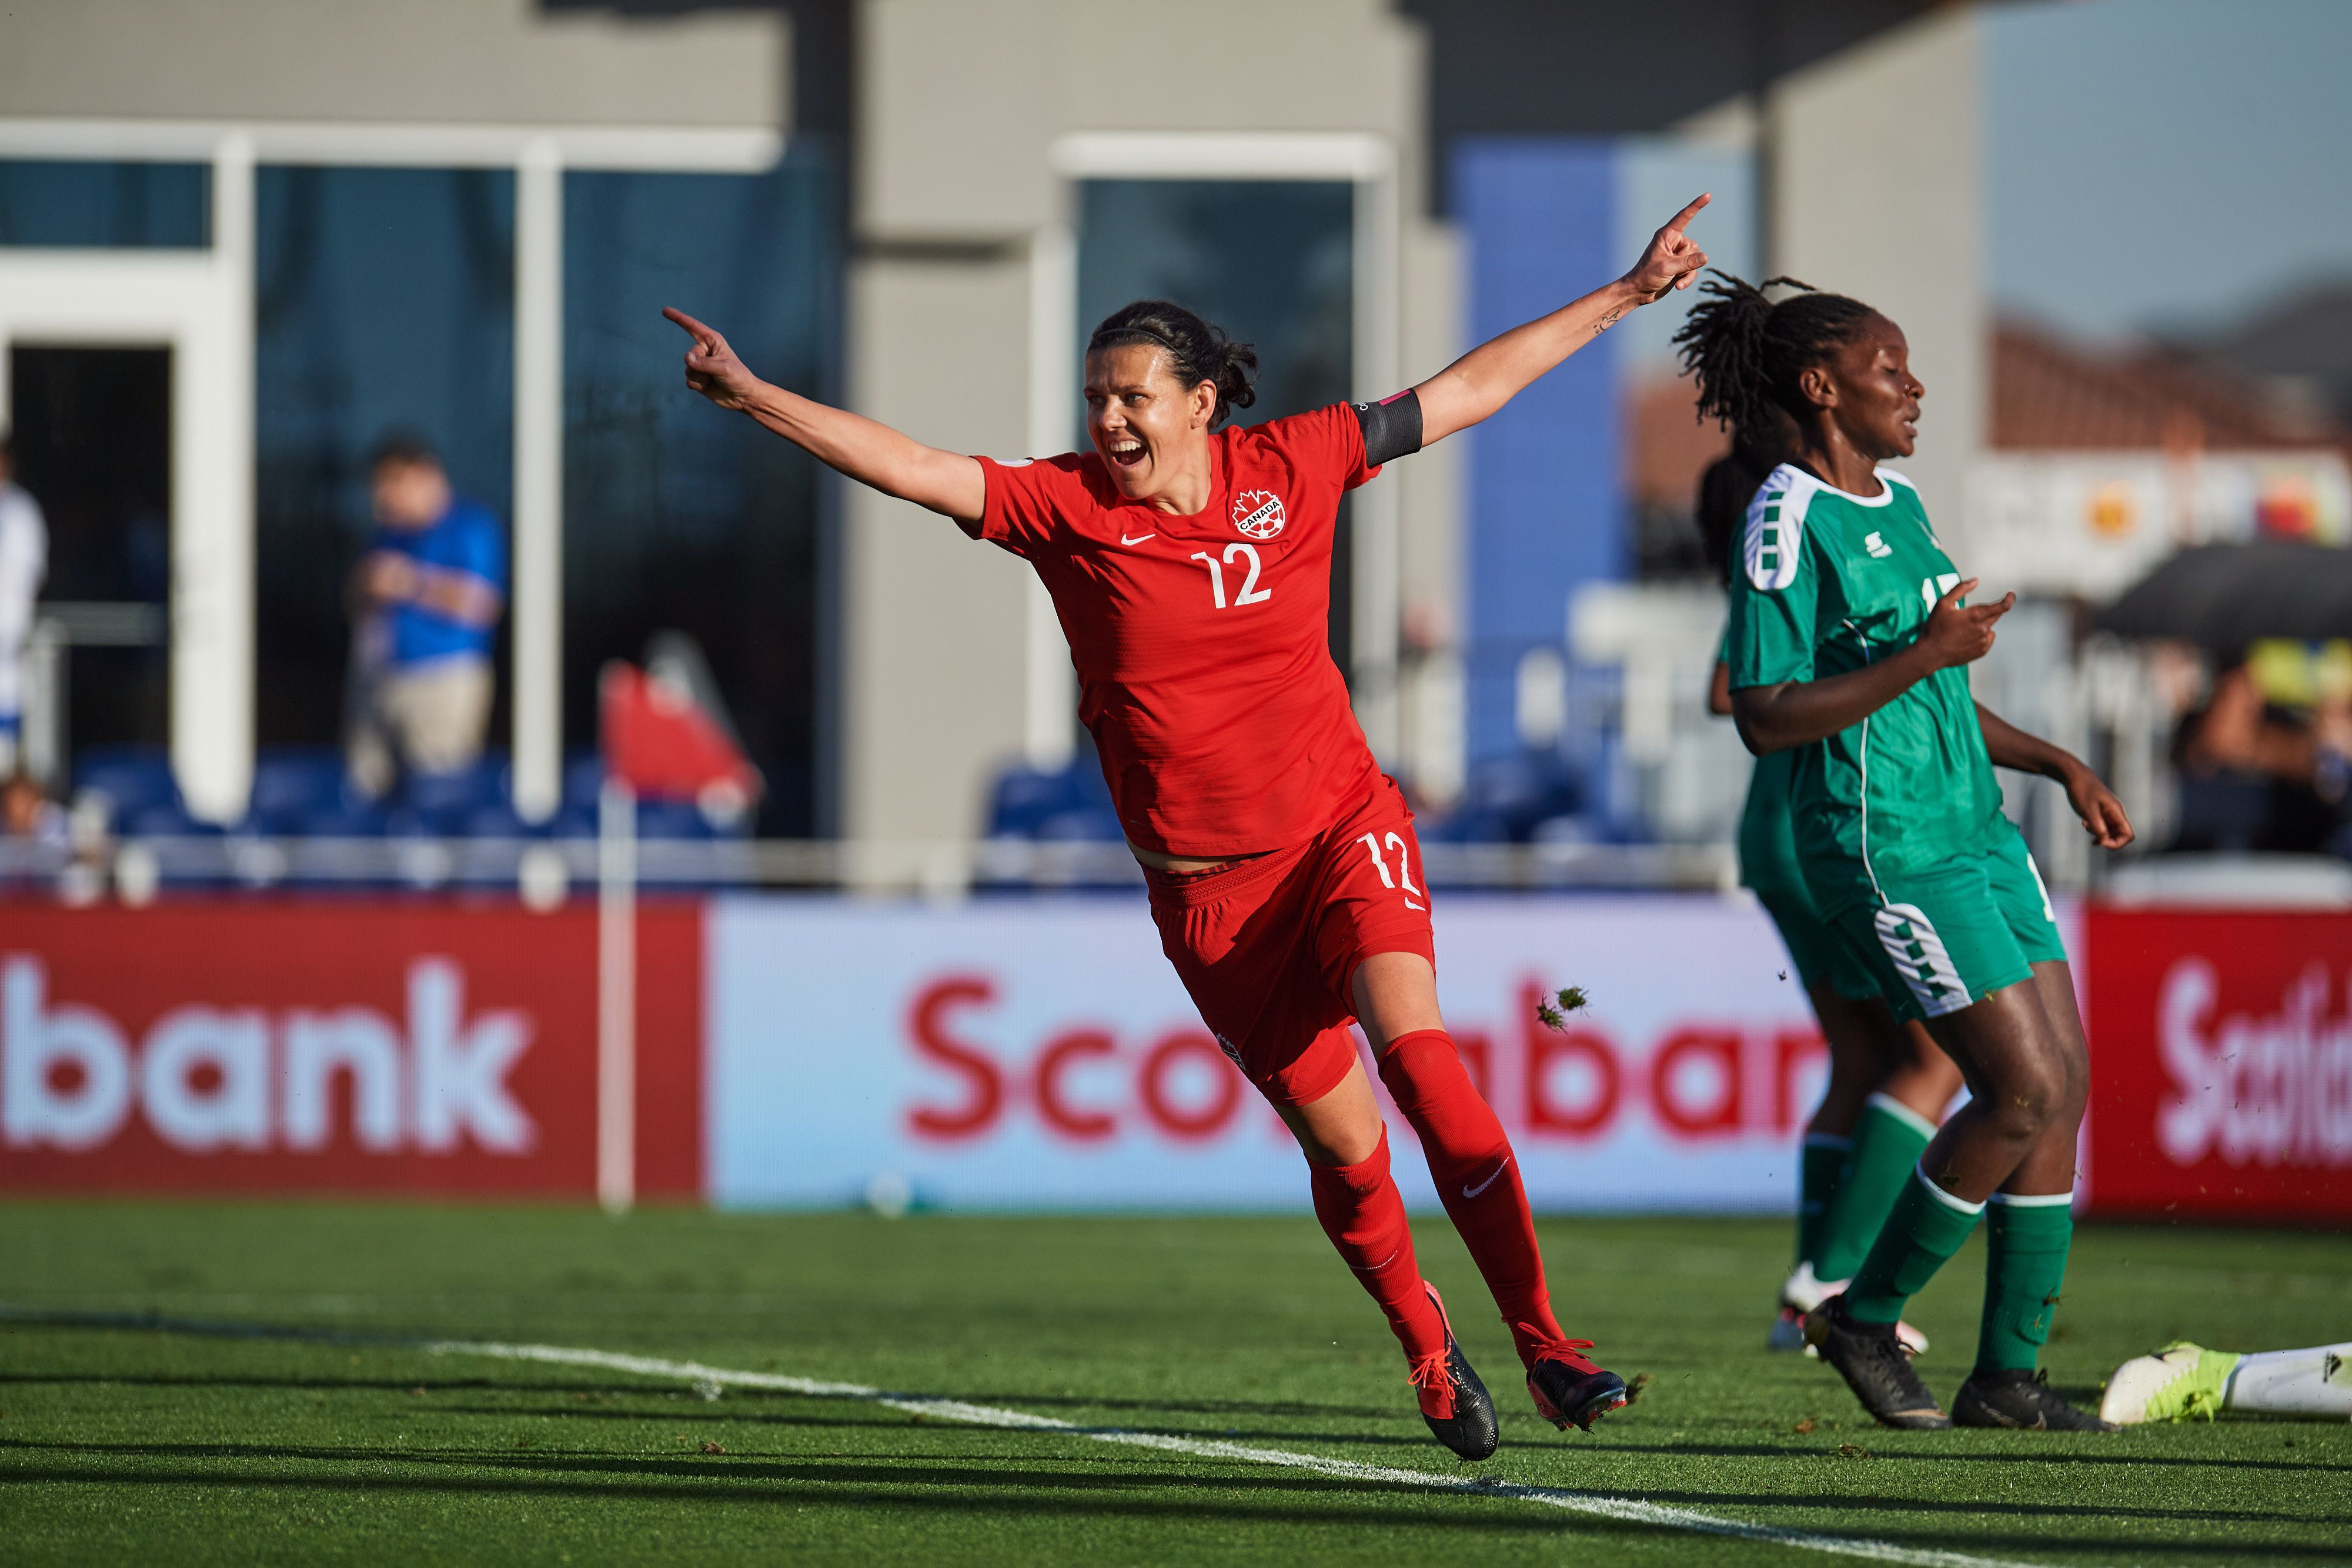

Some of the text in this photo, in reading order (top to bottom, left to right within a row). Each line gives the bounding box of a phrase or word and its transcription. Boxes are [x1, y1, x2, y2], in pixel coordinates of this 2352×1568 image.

[1240, 501, 1280, 530] CANADA
[1190, 543, 1272, 609] 12
[1356, 831, 1422, 897] 12
[0, 954, 538, 1155] bank
